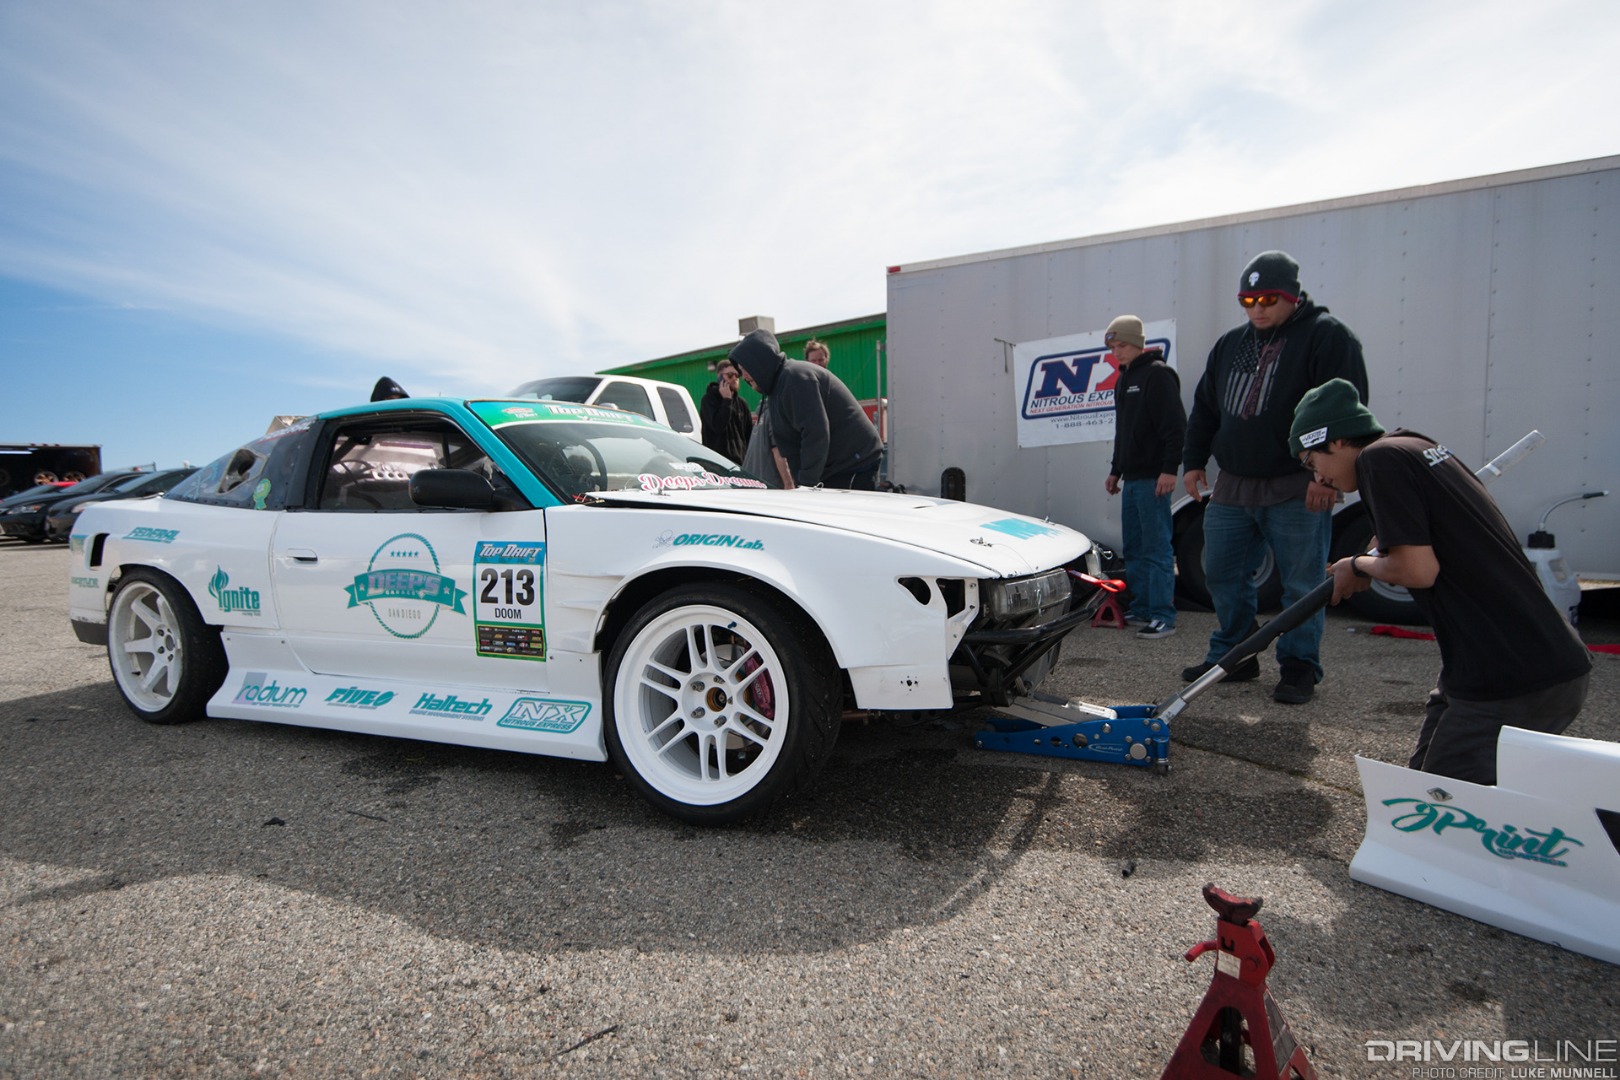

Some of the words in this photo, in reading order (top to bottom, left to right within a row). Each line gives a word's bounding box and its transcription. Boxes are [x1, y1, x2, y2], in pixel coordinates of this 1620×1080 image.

[1030, 393, 1085, 409] NITROUS
[1088, 390, 1116, 402] EXP
[1045, 404, 1085, 413] GENERATION
[1086, 400, 1114, 408] NITROUS
[1050, 412, 1115, 423] www.NitrousExpre
[1055, 418, 1114, 429] 1-888-463-2
[127, 526, 181, 541] FEDERAL
[673, 533, 740, 547] ORIGIN
[480, 567, 535, 606] 213
[388, 607, 400, 619] SAN
[401, 608, 421, 620] DIEGO
[494, 607, 522, 619] DOOM
[235, 680, 308, 704] radium
[412, 692, 493, 716] Haltech
[508, 701, 586, 725] NX
[502, 718, 536, 727] NITROUS
[535, 721, 574, 731] EXPRESS
